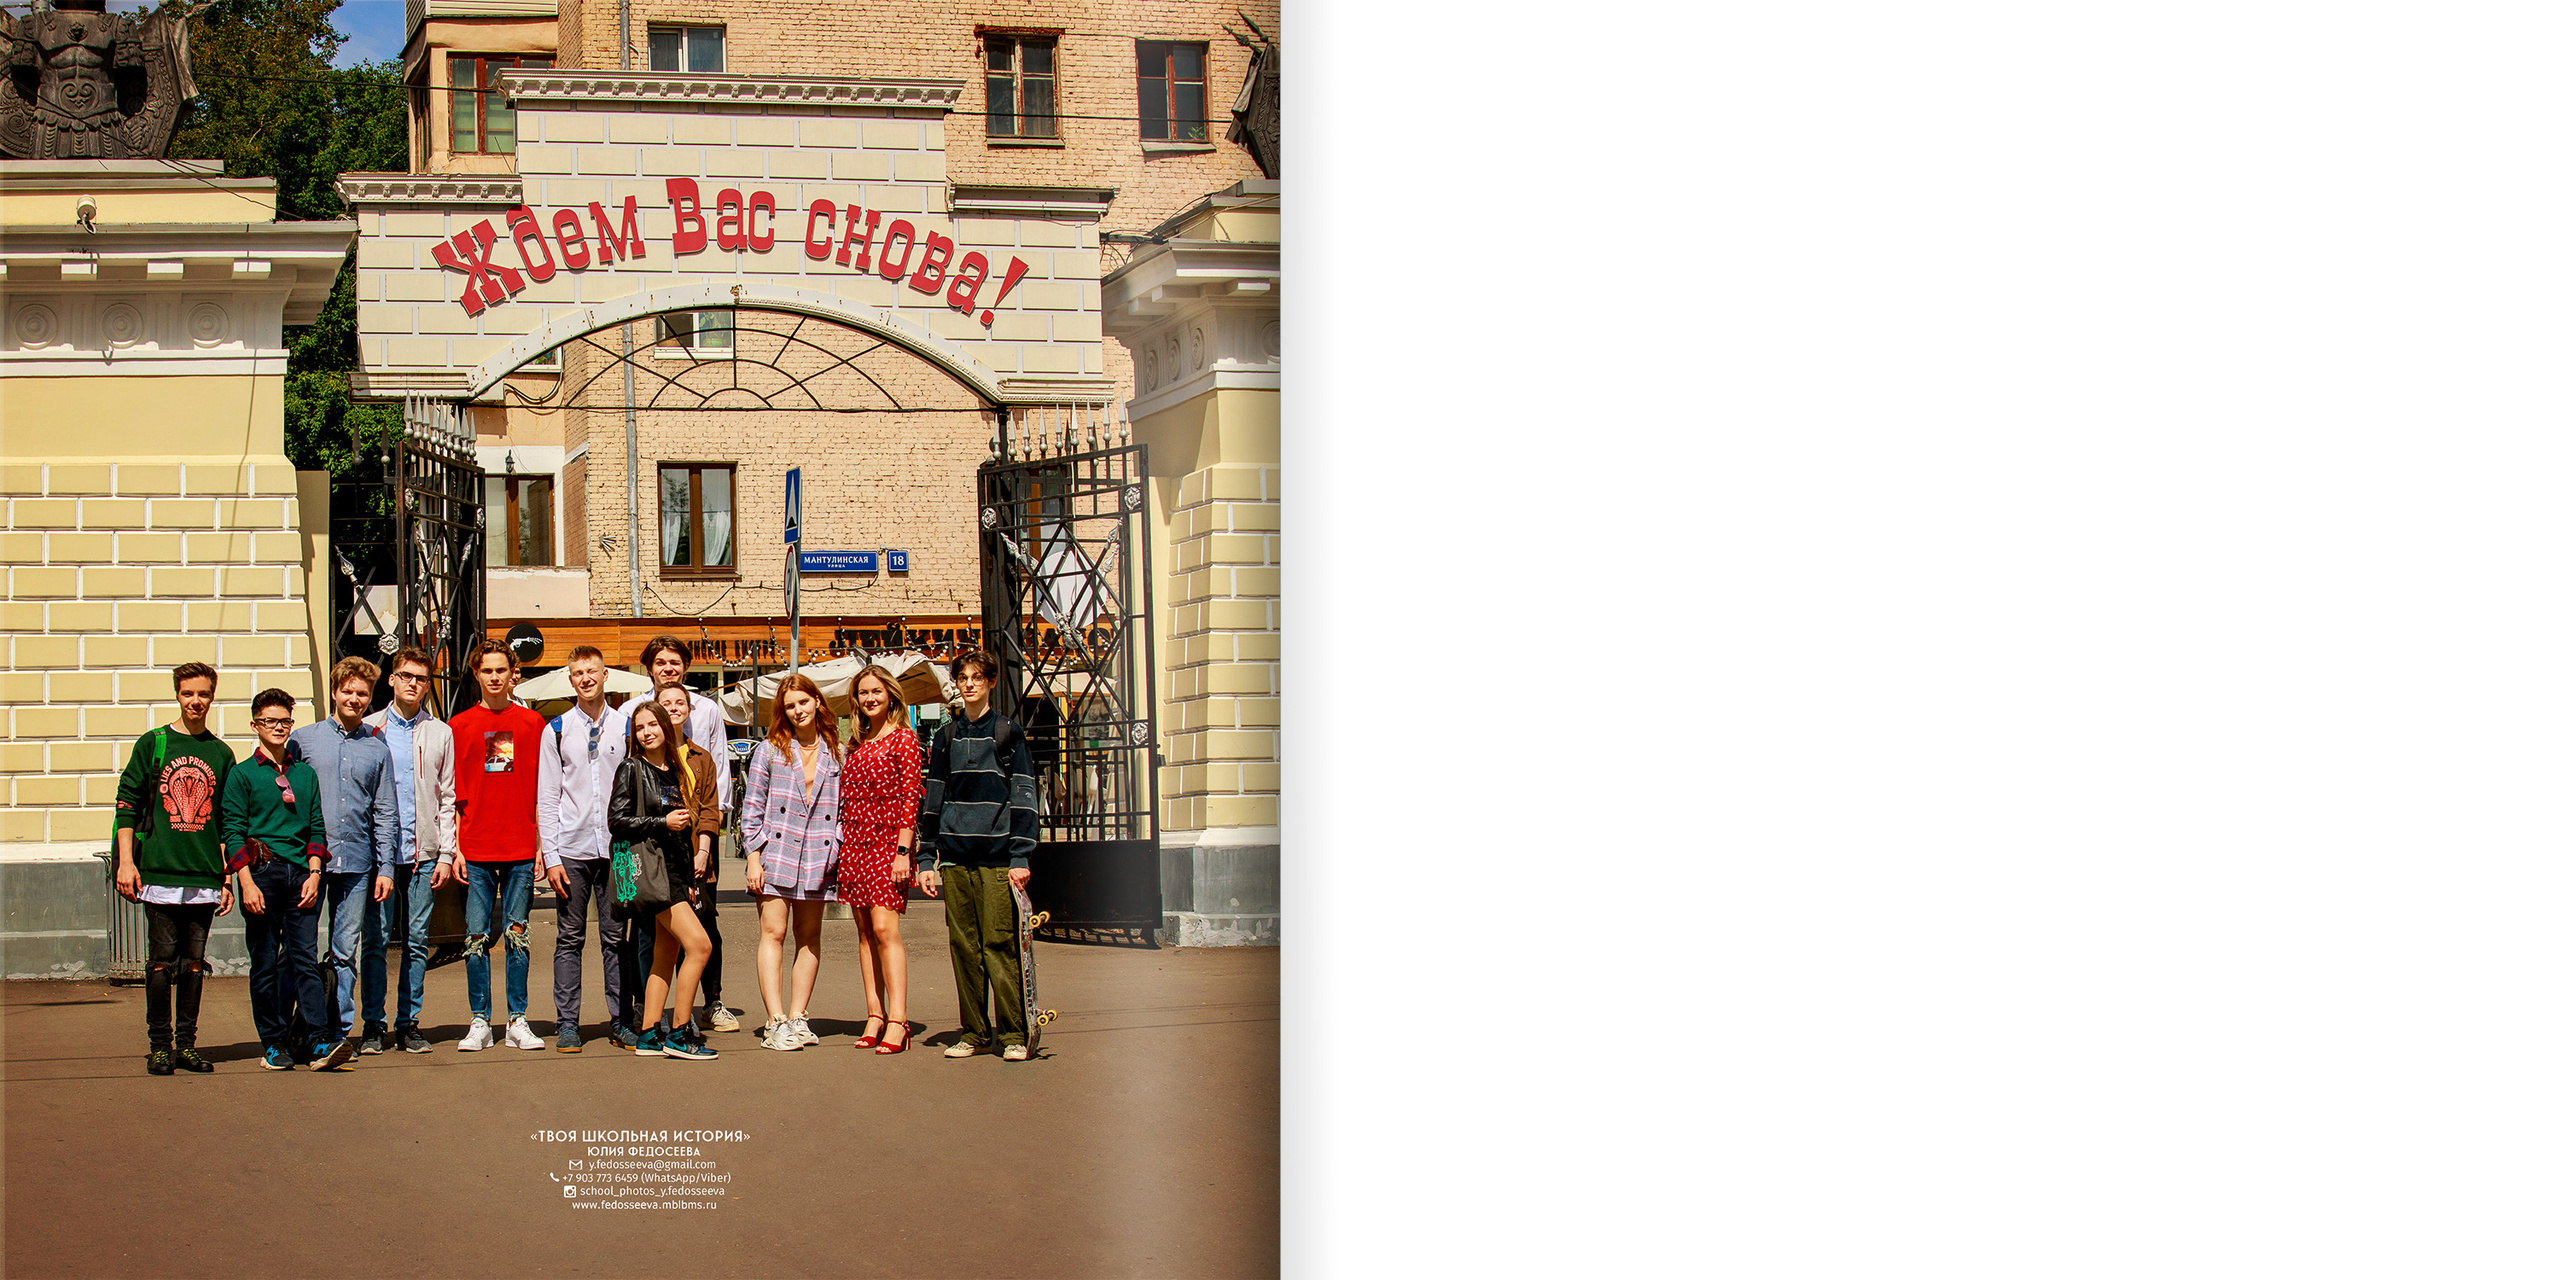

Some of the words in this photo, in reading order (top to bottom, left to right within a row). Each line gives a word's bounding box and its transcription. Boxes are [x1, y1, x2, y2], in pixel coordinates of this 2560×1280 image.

[431, 177, 646, 316] Ждем
[665, 177, 777, 254] Вас
[804, 195, 1030, 327] снова!
[803, 556, 869, 564] МАНТУЛИНСКАЯ
[892, 555, 905, 566] 18
[160, 765, 173, 783] LIES
[170, 756, 188, 769] AND
[188, 755, 217, 786] PROMISES
